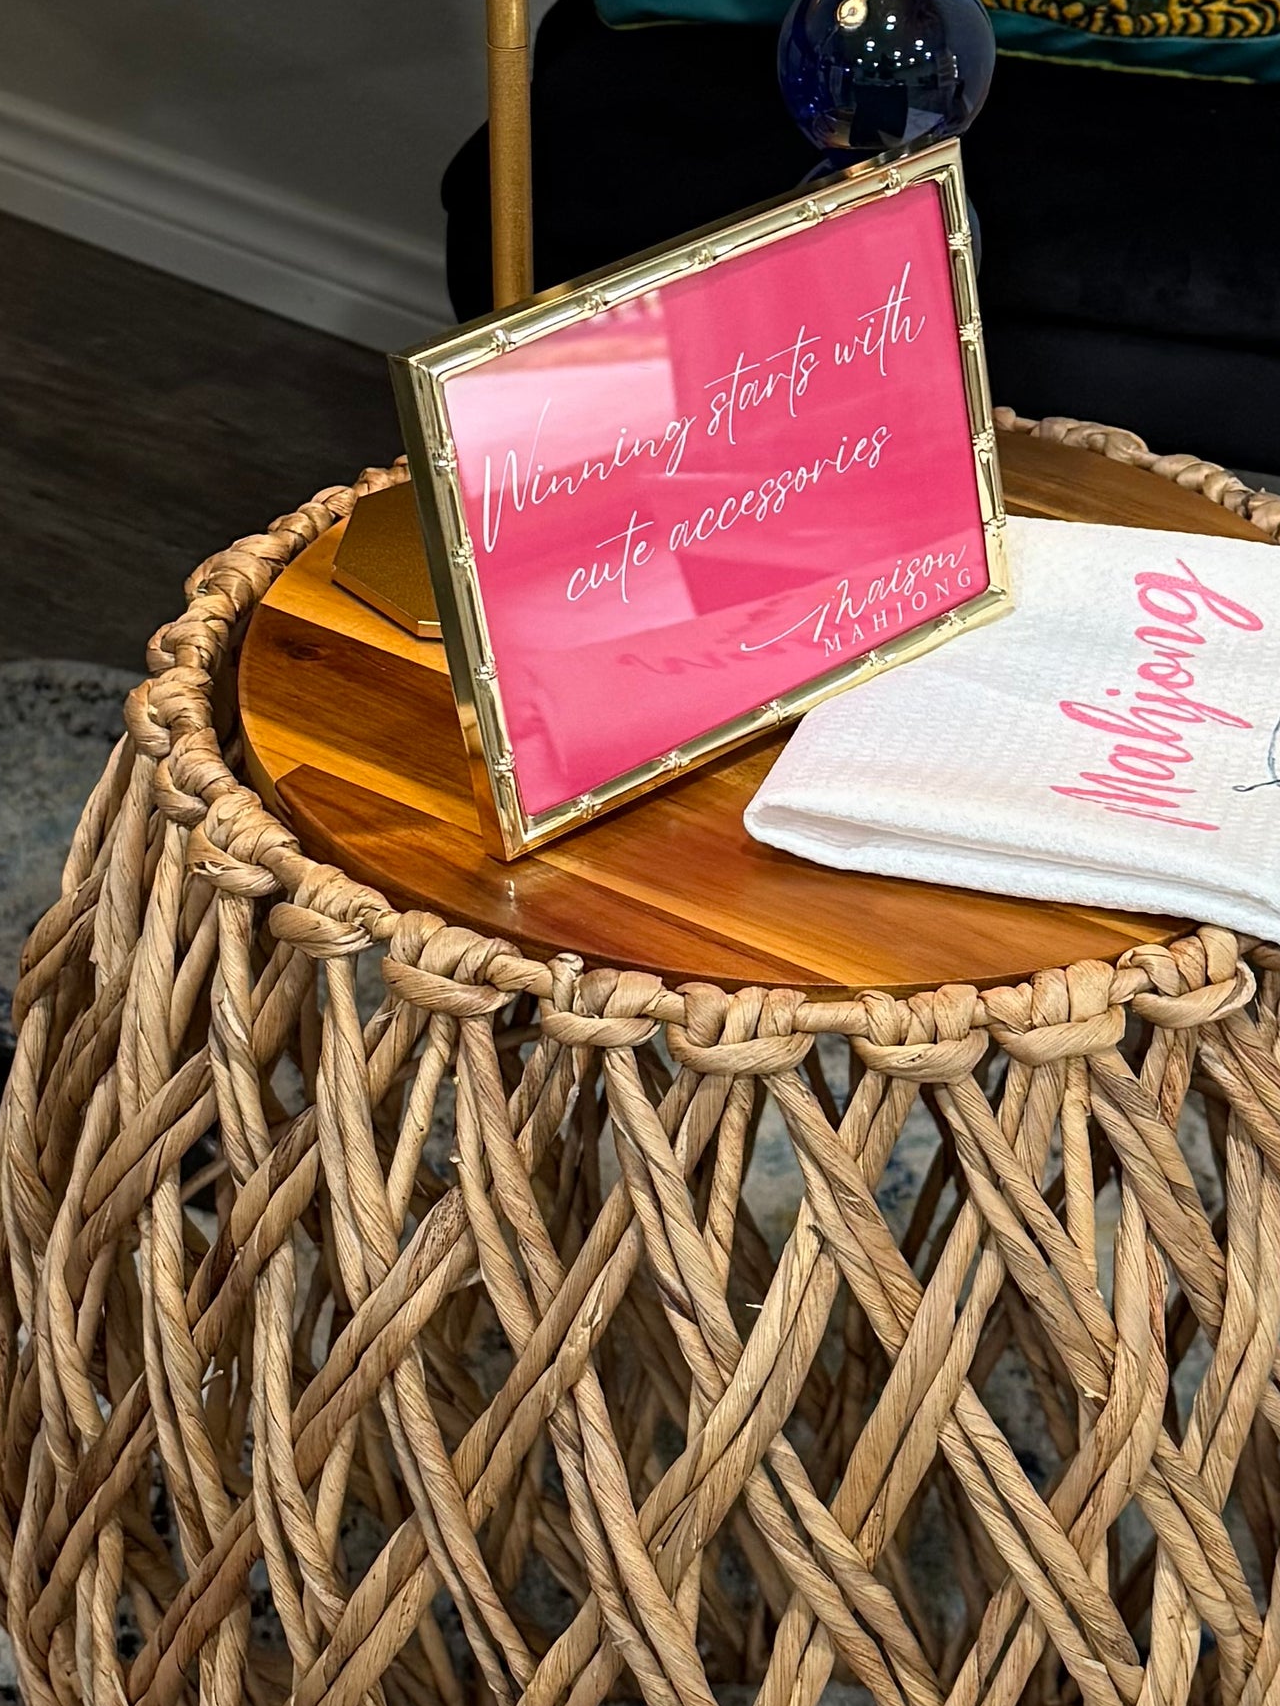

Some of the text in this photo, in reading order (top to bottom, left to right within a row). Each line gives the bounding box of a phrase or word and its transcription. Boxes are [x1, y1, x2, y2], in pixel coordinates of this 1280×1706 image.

[480, 261, 926, 553] Winning starts with
[565, 423, 893, 603] cute accessories
[823, 571, 975, 659] MAHJONG
[1050, 556, 1265, 833] Mahjong
